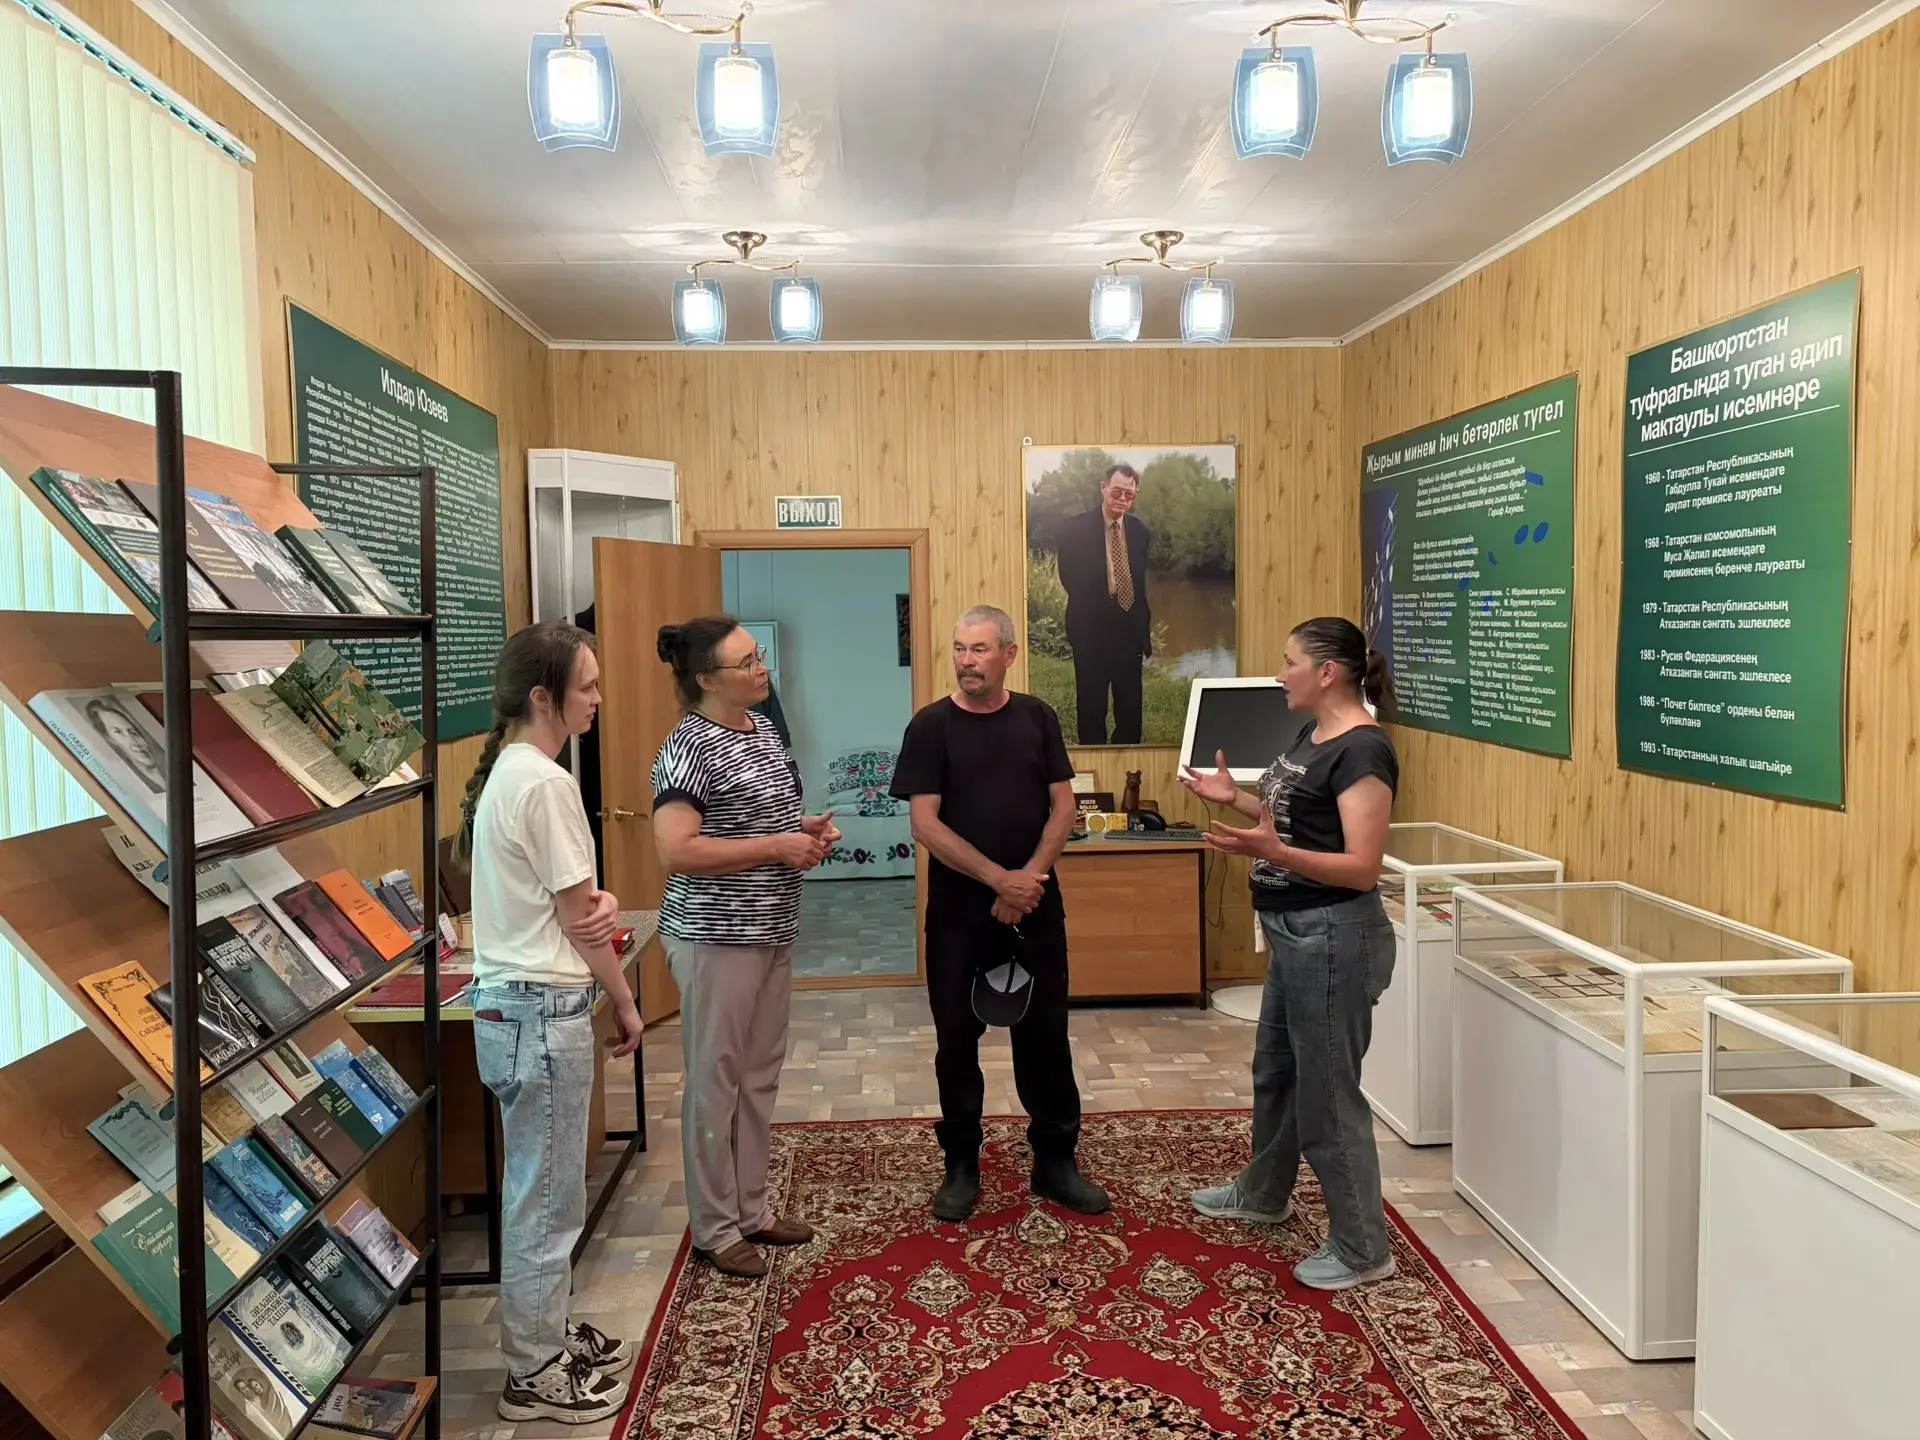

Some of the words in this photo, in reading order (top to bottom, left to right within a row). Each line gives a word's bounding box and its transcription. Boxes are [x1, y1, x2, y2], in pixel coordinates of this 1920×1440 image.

[1670, 314, 1789, 373] Башкортстан
[1629, 369, 1730, 420] туфрагында
[1733, 347, 1786, 390] туган
[1789, 333, 1843, 371] әдип
[380, 366, 415, 411] Илдар
[416, 386, 448, 422] Юзеев
[1641, 404, 1719, 442] мактаулы
[1722, 377, 1820, 420] исемнәре
[1366, 450, 1401, 475] Җырым
[1403, 439, 1436, 462] минем
[1462, 413, 1519, 445] бетәрлек
[1523, 399, 1563, 431] түгел
[1644, 471, 1660, 484] 1960
[1665, 464, 1704, 480] Татарстан
[1706, 446, 1794, 472] Республикасының
[1665, 480, 1701, 495] Габдулла
[1702, 473, 1727, 490] Тукай
[1729, 465, 1785, 483] исемендәге
[1664, 499, 1691, 513] дәүләт
[1691, 492, 1733, 509] премиясе
[1734, 484, 1781, 502] лауреаты
[779, 501, 839, 525] ВЫХОД
[1644, 536, 1659, 548] 1968
[1664, 533, 1702, 547] Татарстан
[1703, 524, 1776, 541] комсомолының
[1663, 550, 1682, 564] Муса
[1682, 548, 1710, 562] Җәлил
[1711, 543, 1765, 557] исемендәге
[1663, 566, 1713, 580] премиясенең
[1714, 562, 1752, 576] беренче
[1754, 558, 1805, 574] лауреаты
[1642, 602, 1657, 613] 1979
[1662, 601, 1700, 614] Татарстан
[1701, 599, 1788, 614] Республикасының
[1659, 617, 1700, 629] Атказанган
[1702, 619, 1735, 628] сәнгать
[1737, 618, 1791, 628] эшлеклесе
[1639, 648, 1655, 660] 1983
[1660, 649, 1682, 663] Русия
[1684, 650, 1758, 665] Федерациясенең
[1659, 665, 1702, 678] Атказанган
[1703, 669, 1737, 680] сәнгать
[1739, 671, 1791, 683] эшлеклесе
[1638, 695, 1654, 707] 1986
[1727, 705, 1762, 717] ордены
[1764, 705, 1794, 720] белән
[1660, 712, 1701, 727] бүләкләнә
[1640, 740, 1656, 753] 1993
[1661, 743, 1718, 764] Татарстанның
[1719, 754, 1747, 767] халык
[1748, 759, 1792, 776] шагыйре
[204, 966, 214, 978] НЕ
[212, 974, 241, 1005] ПЕРЕБИВАЙ
[237, 1001, 263, 1029] МЕРТВЫХ
[251, 1296, 285, 1330] ТЕГЕРМӘН
[267, 1303, 291, 1326] ТАШЫ
